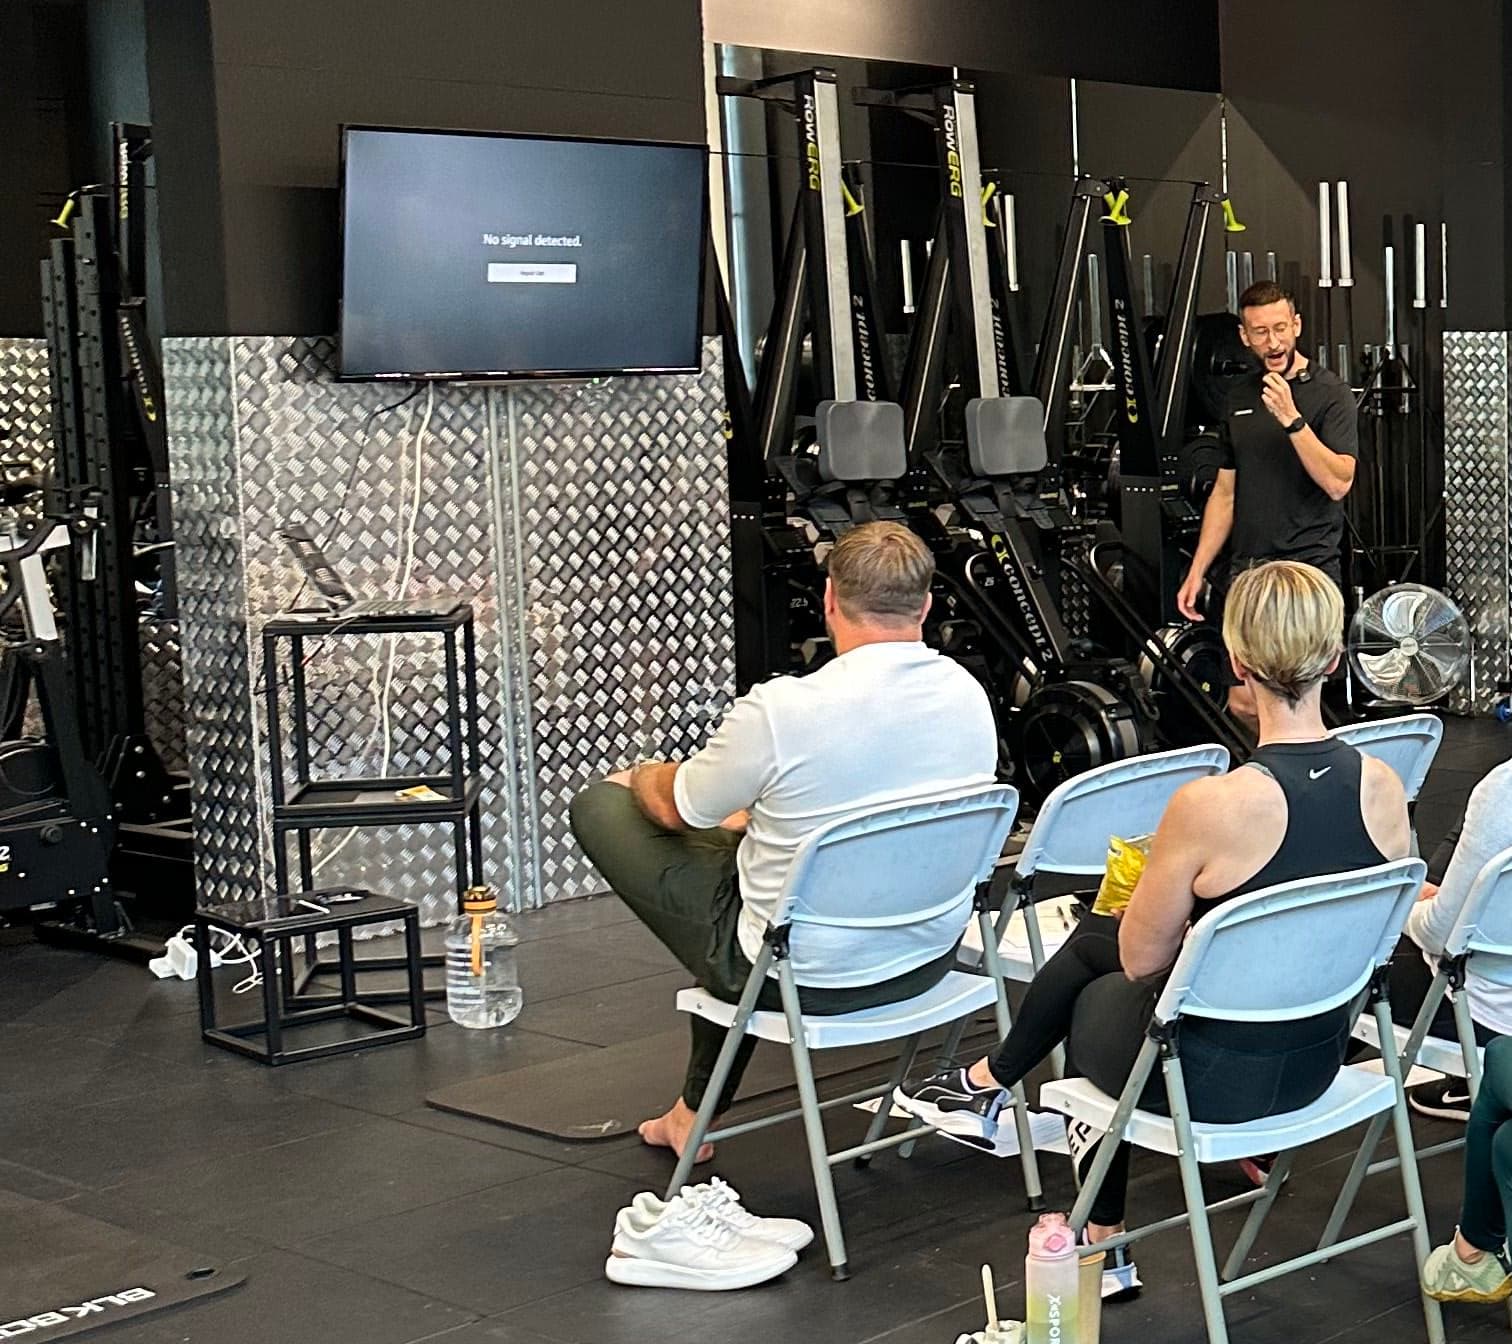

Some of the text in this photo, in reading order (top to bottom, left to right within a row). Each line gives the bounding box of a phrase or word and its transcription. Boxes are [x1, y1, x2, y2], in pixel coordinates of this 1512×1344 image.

[483, 233, 582, 248] No signal detected.
[0, 1310, 70, 1340] BO
